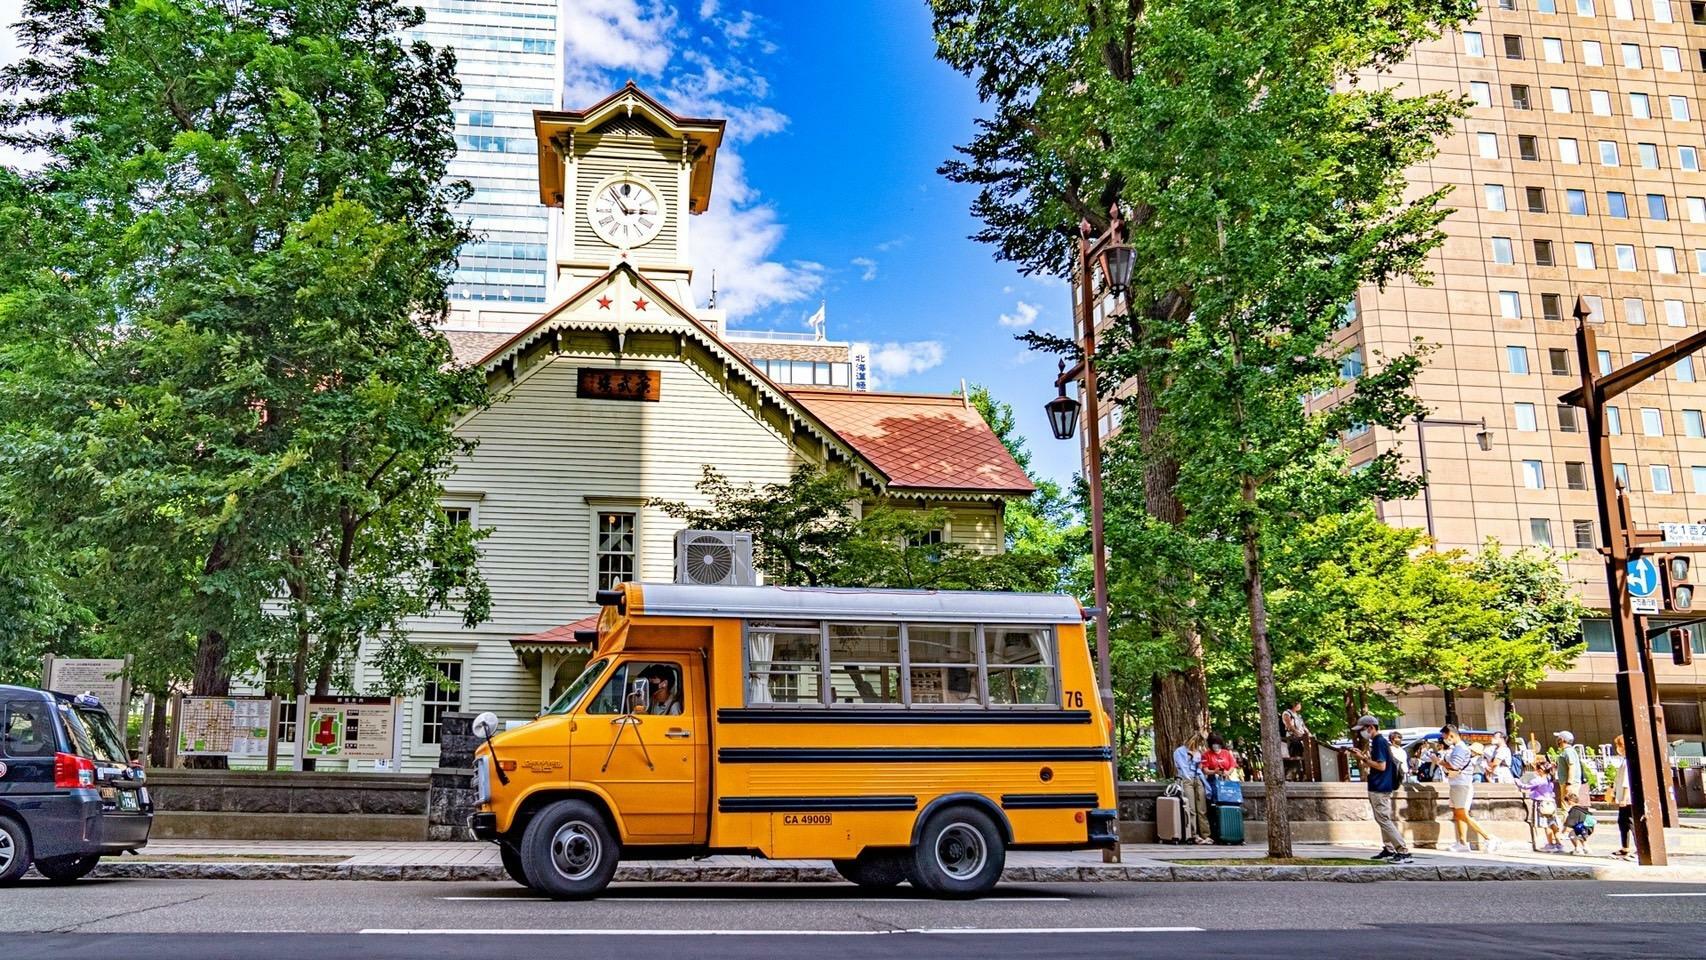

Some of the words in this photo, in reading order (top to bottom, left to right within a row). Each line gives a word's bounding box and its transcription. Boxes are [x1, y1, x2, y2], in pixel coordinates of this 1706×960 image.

[1065, 691, 1083, 708] 76
[785, 815, 798, 824] CA
[801, 815, 830, 824] 49009
